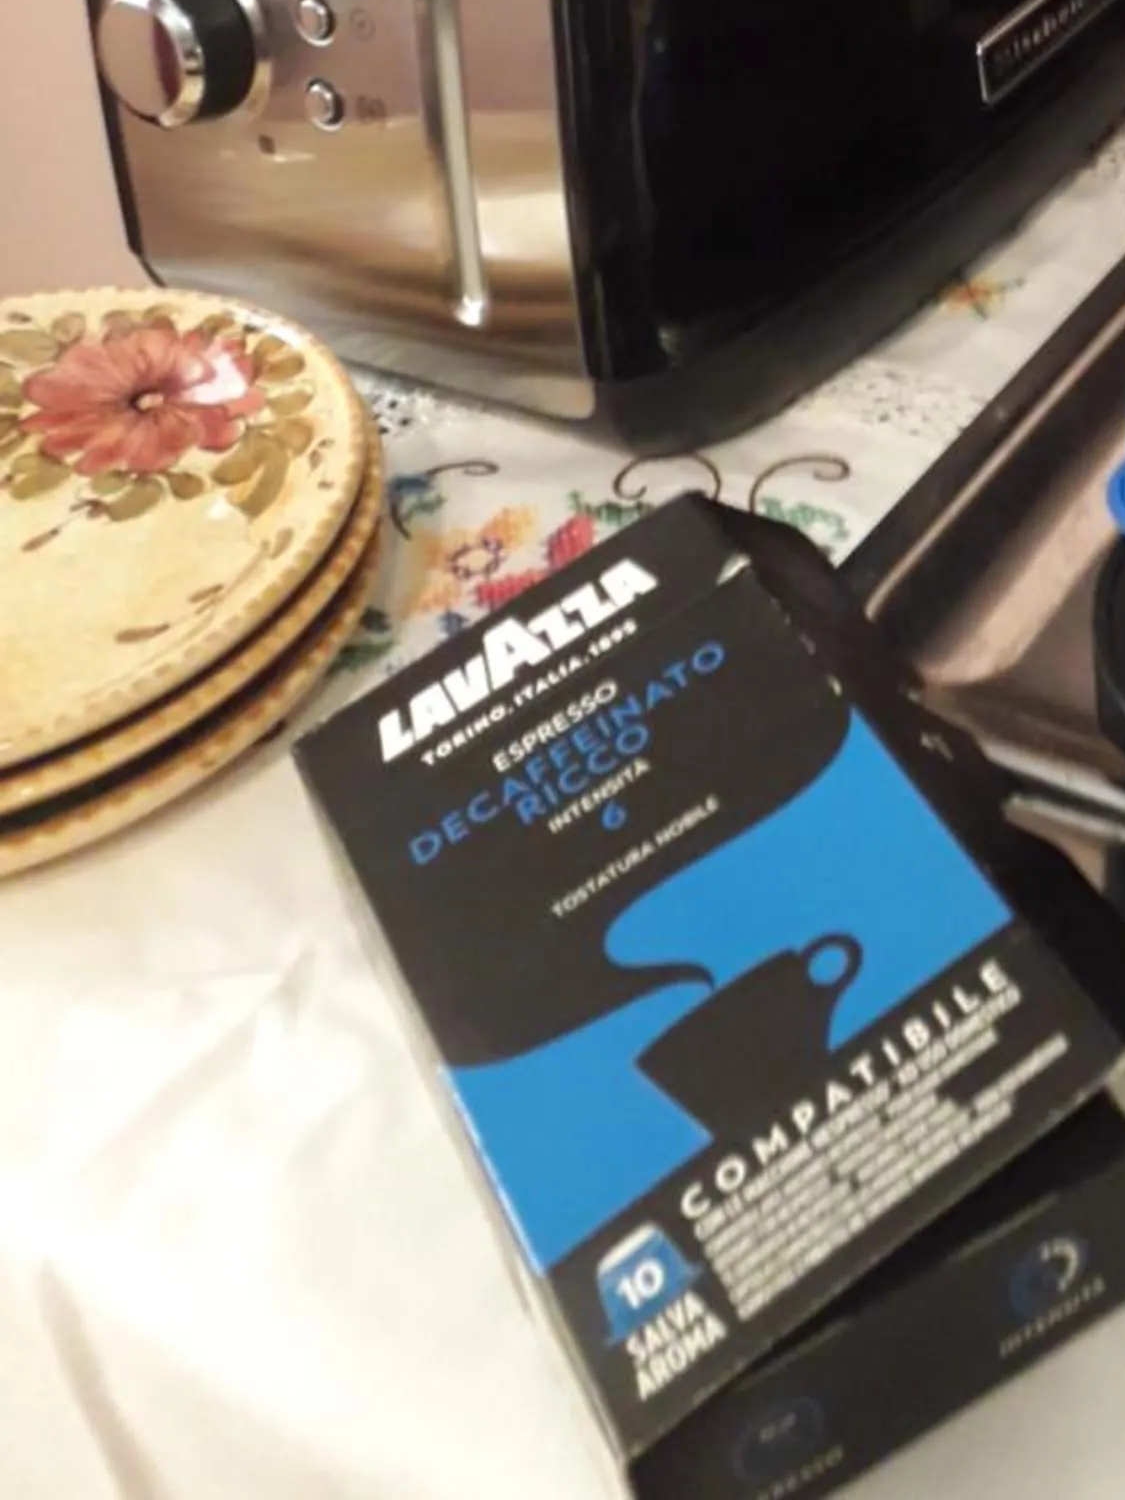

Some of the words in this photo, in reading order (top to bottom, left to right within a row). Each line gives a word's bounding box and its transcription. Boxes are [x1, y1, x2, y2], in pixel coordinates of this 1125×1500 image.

[378, 558, 658, 763] LAVAZZA
[408, 641, 724, 866] DECAFFEINATO
[492, 678, 618, 773] ESPRESSO
[514, 723, 650, 826] RICCO
[602, 801, 627, 831] 6
[551, 840, 656, 918] TOSTATURA
[680, 958, 1009, 1220] COMPATIBILE
[616, 1259, 664, 1310] 10
[626, 1290, 704, 1362] SALVA
[636, 1313, 727, 1404] AROMA
